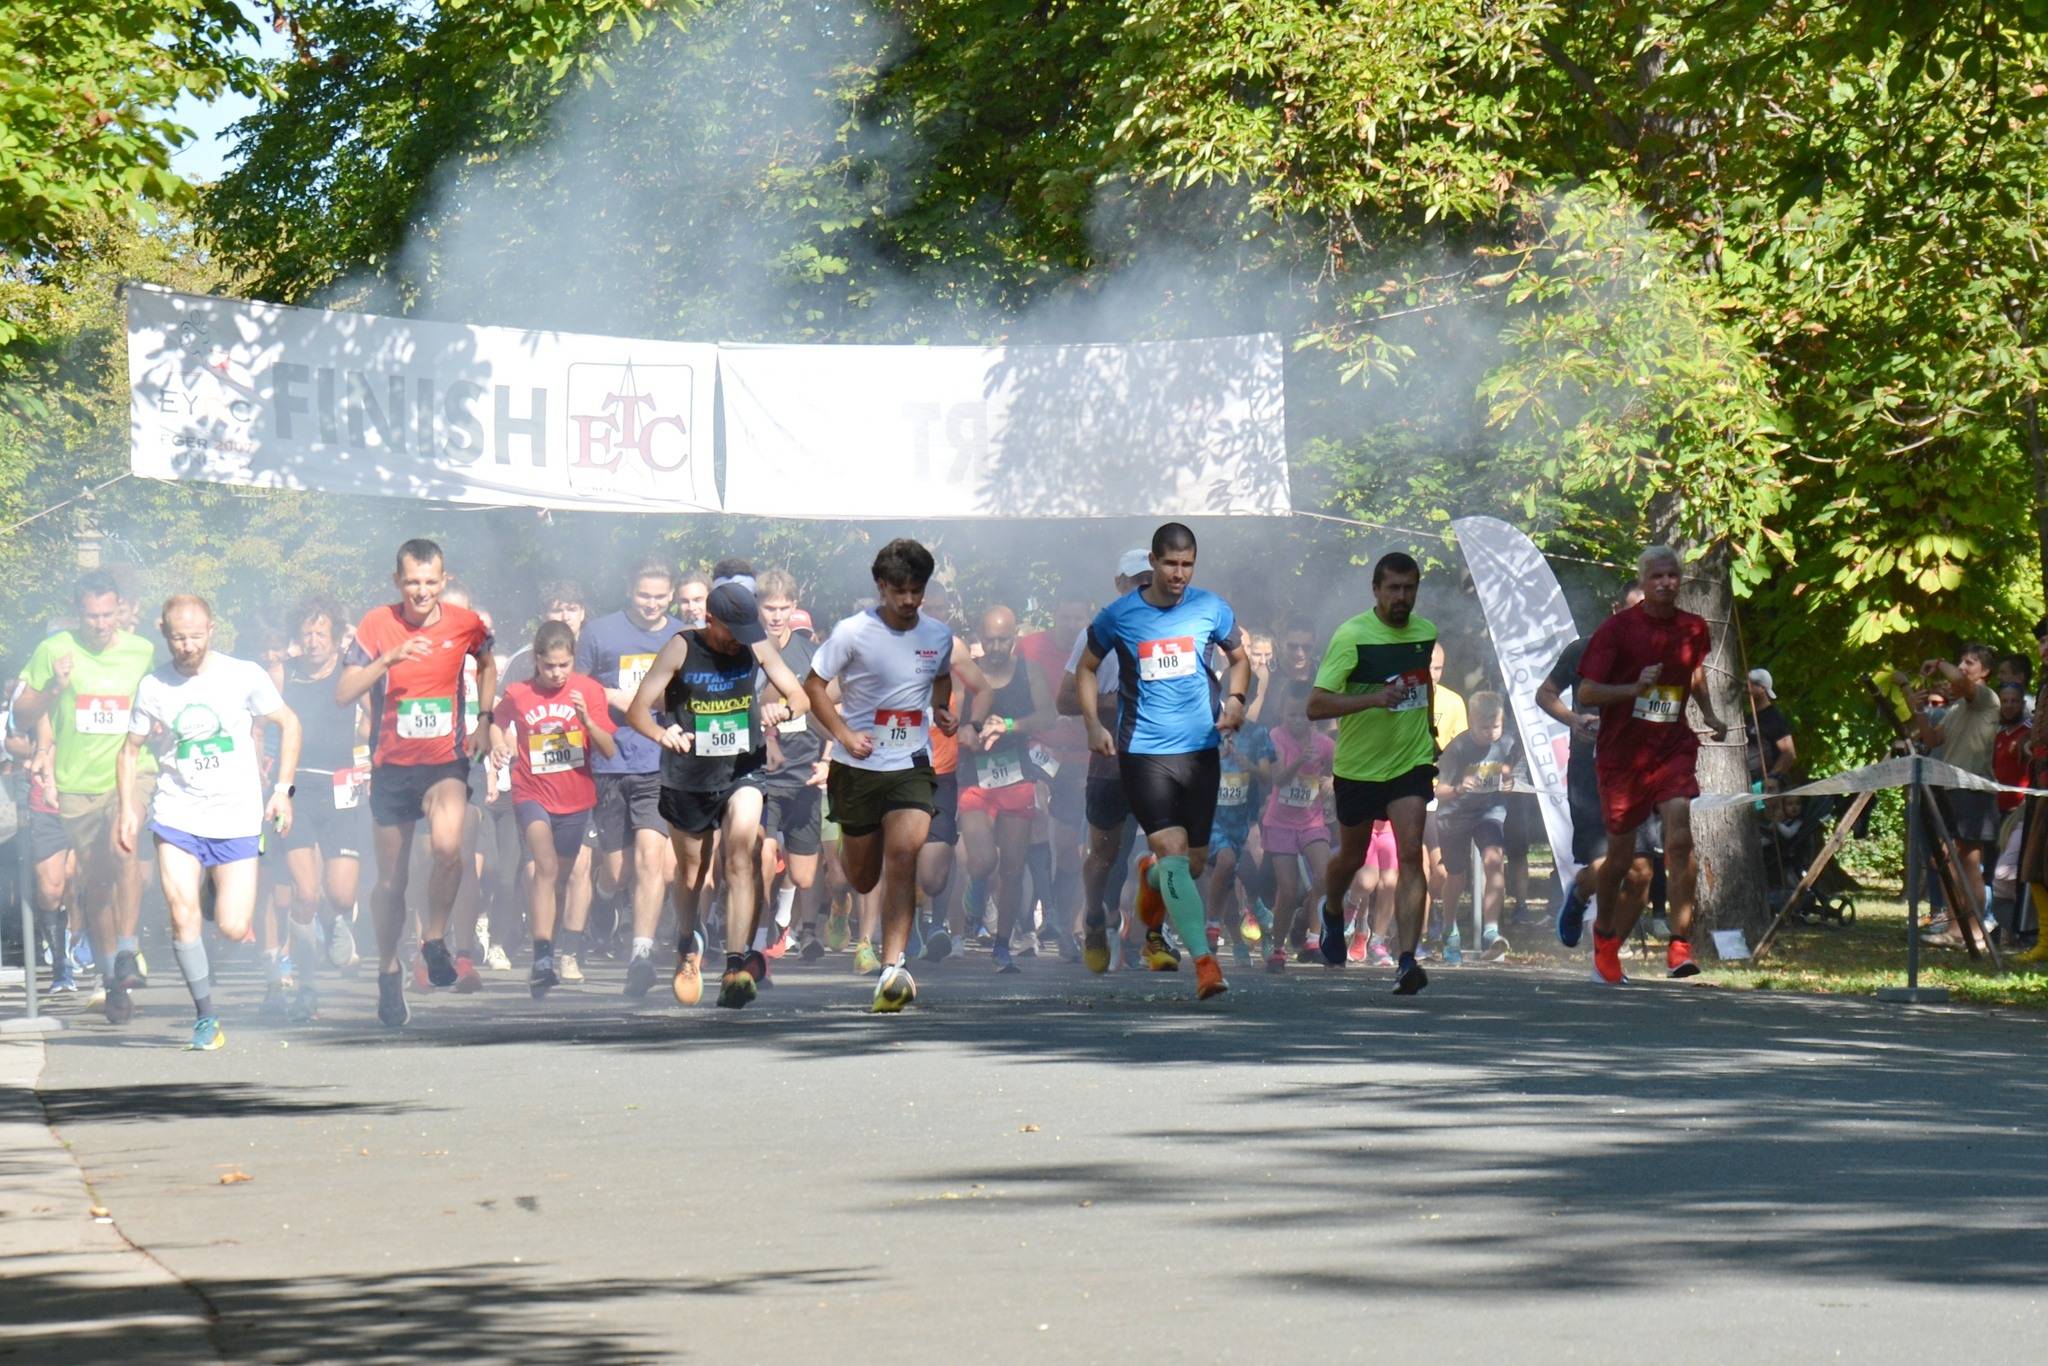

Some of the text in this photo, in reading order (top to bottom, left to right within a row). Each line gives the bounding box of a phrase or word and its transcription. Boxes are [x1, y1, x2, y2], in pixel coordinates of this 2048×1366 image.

[271, 361, 548, 468] FINISH
[570, 391, 690, 476] ETC
[1157, 656, 1179, 668] 108
[93, 712, 114, 725] 133
[415, 714, 437, 728] 513
[524, 703, 577, 726] OLD NAVY
[711, 732, 737, 746] 508
[891, 727, 908, 740] 175
[194, 755, 220, 771] 523
[543, 749, 571, 764] 1300
[991, 767, 1009, 780] 511
